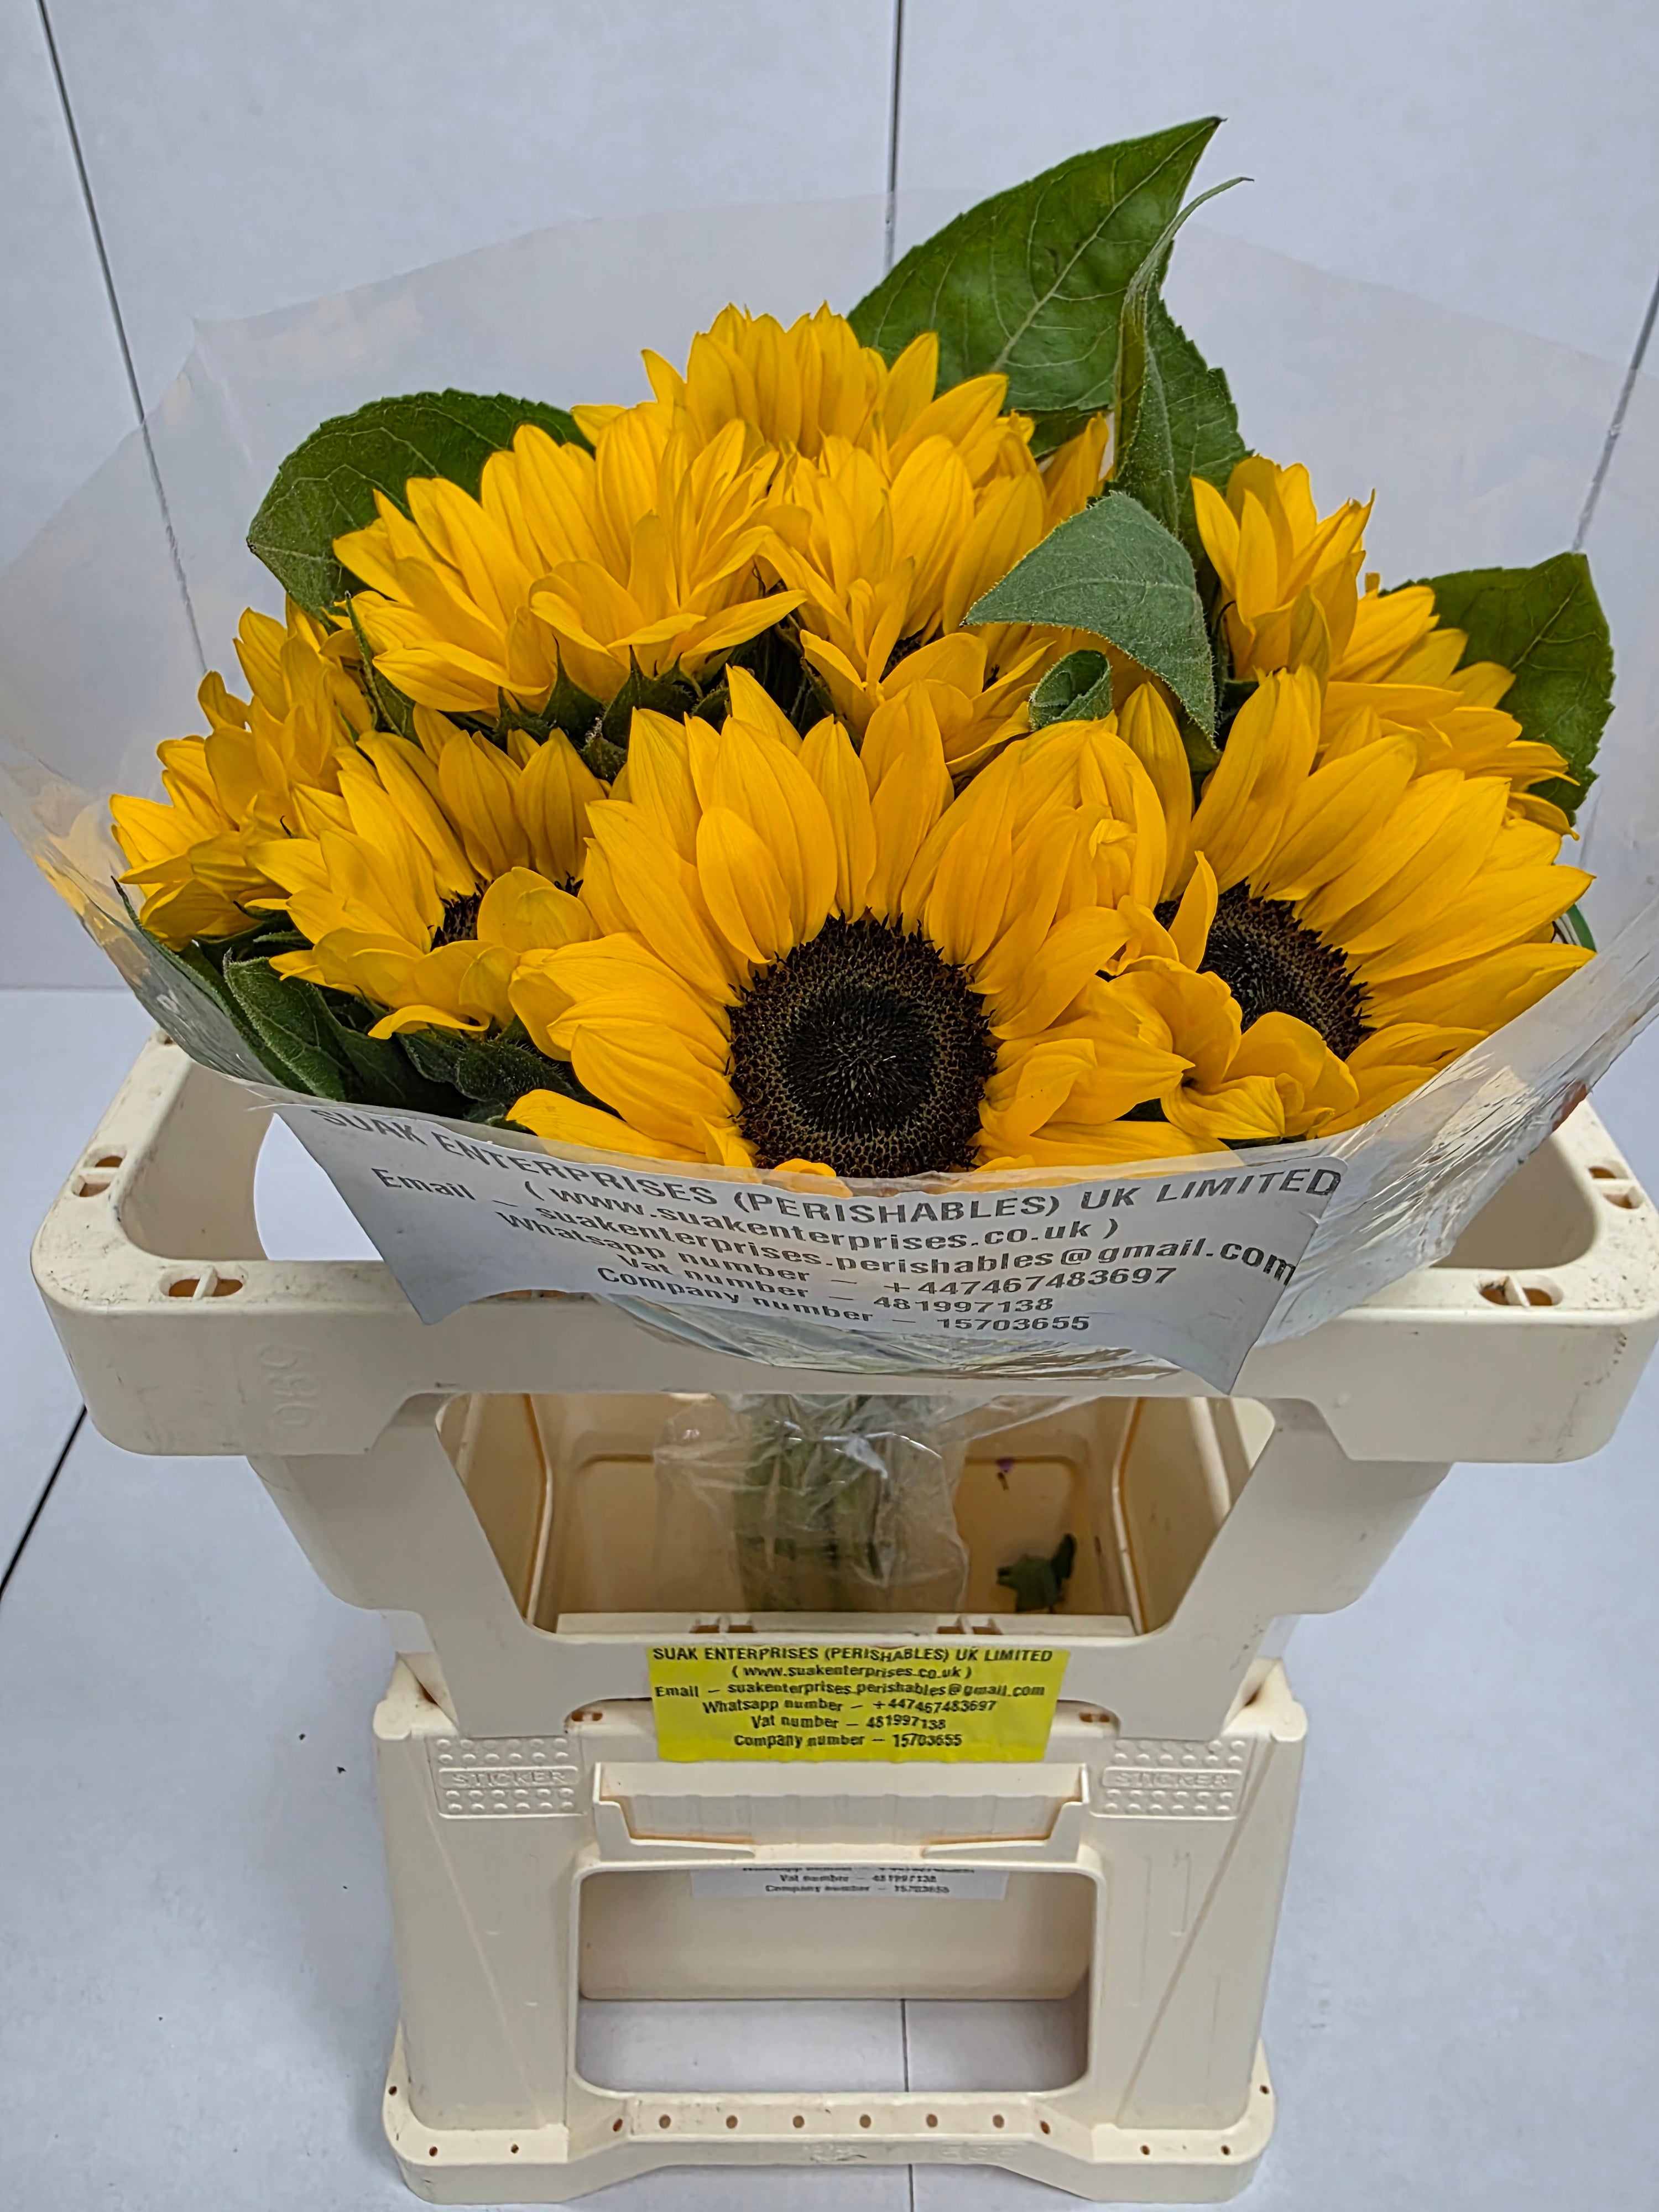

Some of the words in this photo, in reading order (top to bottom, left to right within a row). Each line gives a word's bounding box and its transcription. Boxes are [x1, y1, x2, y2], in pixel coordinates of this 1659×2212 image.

[311, 1109, 428, 1146] SUAK
[431, 1131, 718, 1206] ENTERPRISES
[733, 1191, 1060, 1224] (PERISHABLES)
[1081, 1187, 1141, 1210] UK
[1157, 1168, 1342, 1203] LIMITED
[371, 1167, 476, 1201] Email
[535, 1207, 1297, 1286] suakenterprises.perishables@gmail.com
[496, 1211, 665, 1260] Whatsapp
[678, 1252, 810, 1283] number
[617, 1254, 674, 1275] Vat
[685, 1270, 809, 1298] number
[874, 1297, 1053, 1313] 481997138
[597, 1267, 739, 1305] Company
[753, 1297, 874, 1322] number
[937, 1316, 1090, 1331] 15703655
[653, 1647, 698, 1660] SUAK
[705, 1647, 818, 1660] ENTERPRISES
[825, 1647, 950, 1662] (PERISHABLES)
[956, 1648, 979, 1661] UK
[984, 1650, 1053, 1661] LIMITED
[655, 1686, 698, 1698] Email
[703, 1699, 779, 1714] Whatsapp
[784, 1698, 843, 1712] number
[751, 1715, 775, 1729] Vat
[781, 1715, 839, 1729] number
[866, 1714, 946, 1730] 481997138
[734, 1735, 803, 1749] Company
[807, 1734, 865, 1747] number
[892, 1733, 962, 1747] 15703655
[452, 1771, 565, 1787] STICKER
